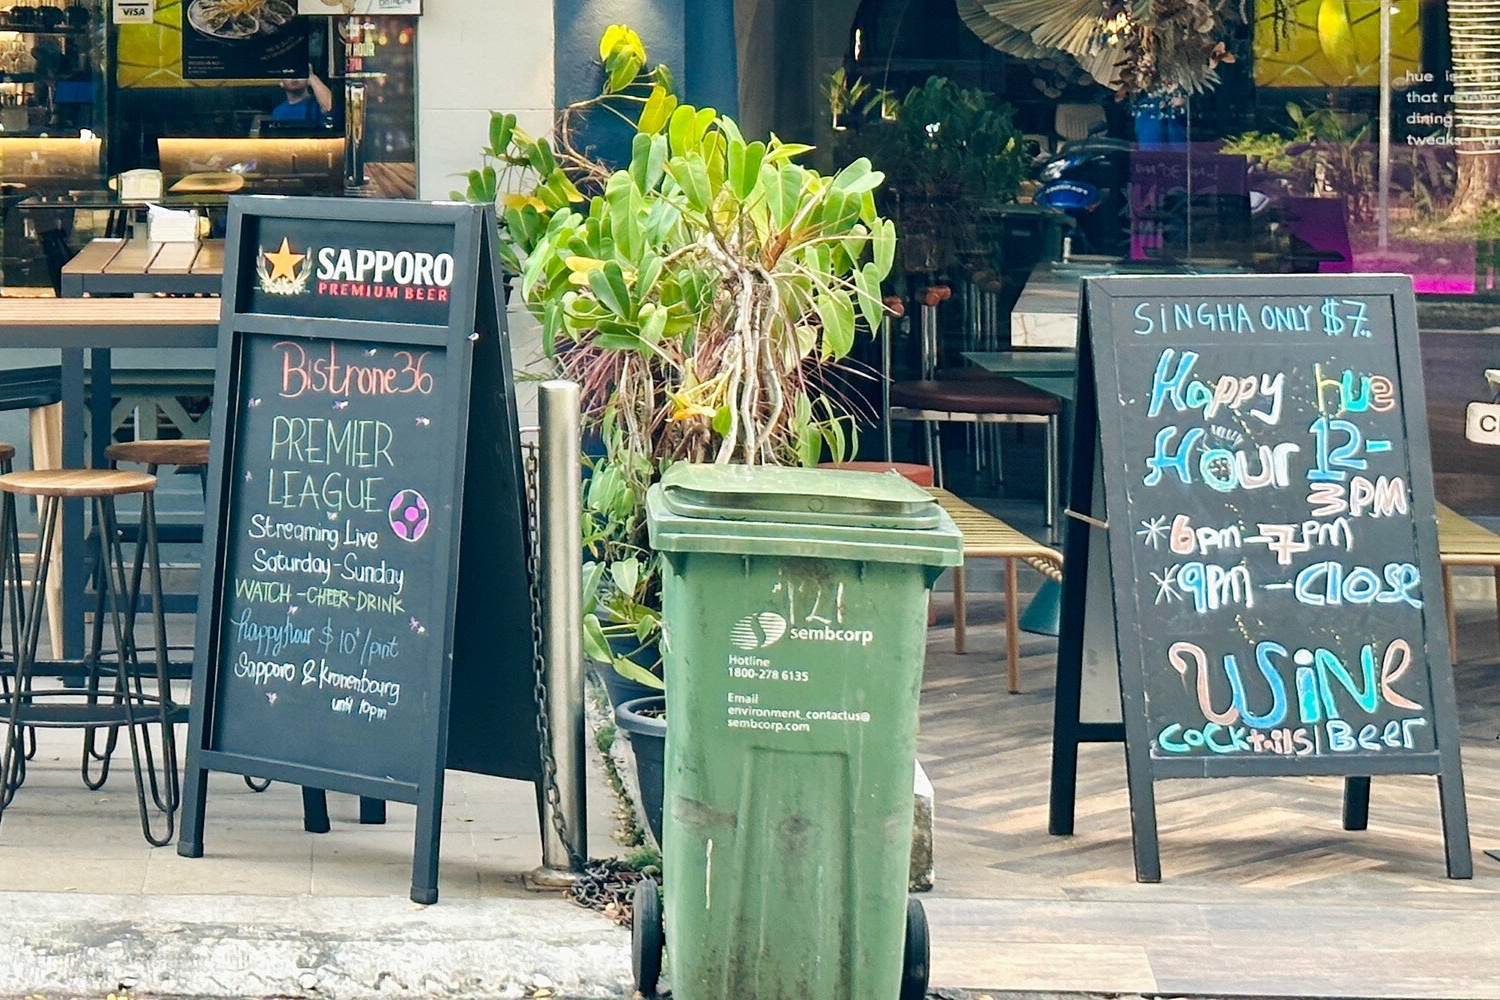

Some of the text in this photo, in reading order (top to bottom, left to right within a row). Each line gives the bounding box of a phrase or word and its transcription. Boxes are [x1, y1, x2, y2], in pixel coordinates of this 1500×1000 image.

[122, 8, 146, 16] VISA
[1405, 69, 1434, 82] hue
[1406, 91, 1438, 103] that
[1406, 112, 1453, 128] dining
[1406, 134, 1461, 146] tweaks
[316, 247, 455, 287] SAPPORO
[317, 281, 450, 302] PREMIUM BEER
[1261, 304, 1312, 332] ONLY
[1147, 348, 1396, 426] Happy hue
[270, 416, 395, 468] PREMIER
[1143, 425, 1301, 493] Hour
[268, 468, 385, 513] LEAGUE
[248, 513, 379, 550] Streaming Live
[235, 578, 292, 603] WATCH
[787, 577, 844, 625] 121
[789, 625, 874, 646] sembcorp
[234, 651, 296, 685] Sapporo
[301, 659, 317, 686] &
[728, 654, 771, 668] Hotline
[728, 666, 809, 682] 1800-278 6135
[727, 692, 759, 705] Email
[358, 699, 387, 722] 10pm
[727, 705, 871, 723] environment_contactus@
[727, 717, 810, 733] sembcorp.com
[1326, 718, 1428, 750] Beer
